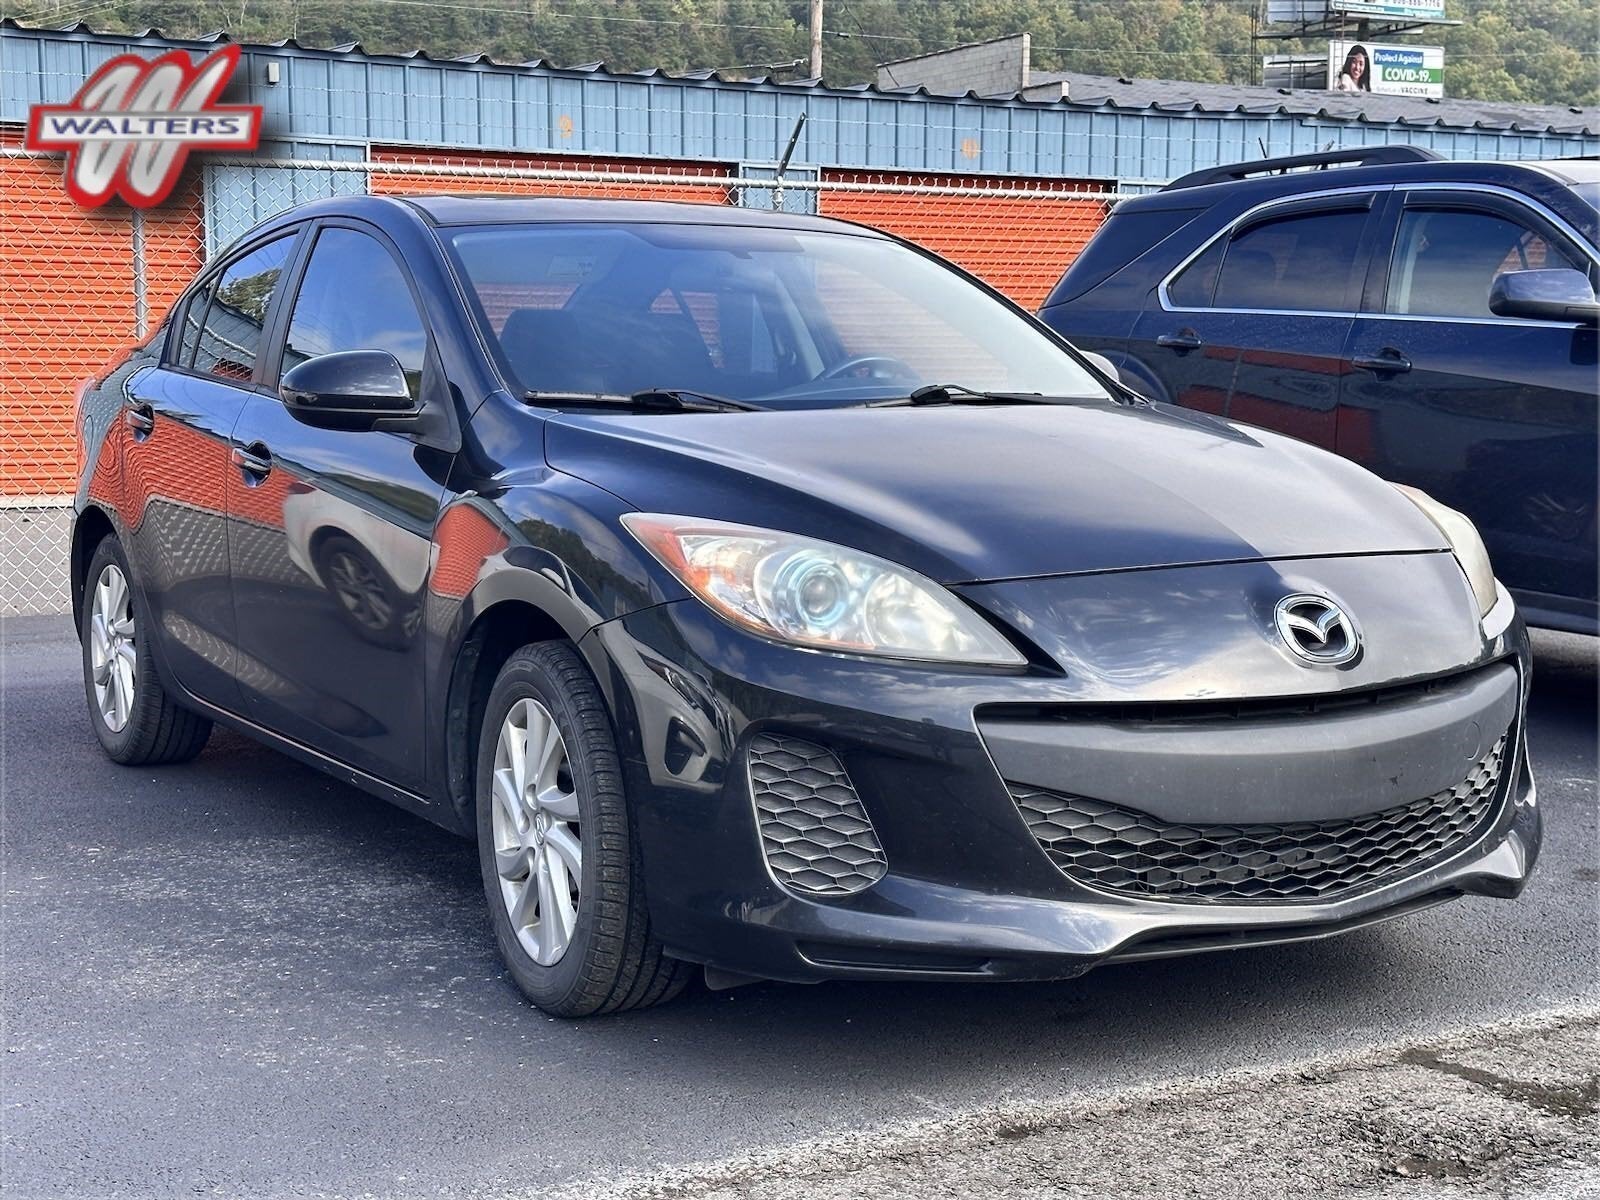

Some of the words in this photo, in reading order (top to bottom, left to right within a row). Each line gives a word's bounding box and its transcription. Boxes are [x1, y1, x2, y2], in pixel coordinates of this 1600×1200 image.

[1375, 52, 1397, 62] Protect
[1398, 53, 1422, 65] Against
[1385, 67, 1432, 82] COVID-19.
[1401, 87, 1428, 95] VACCINE
